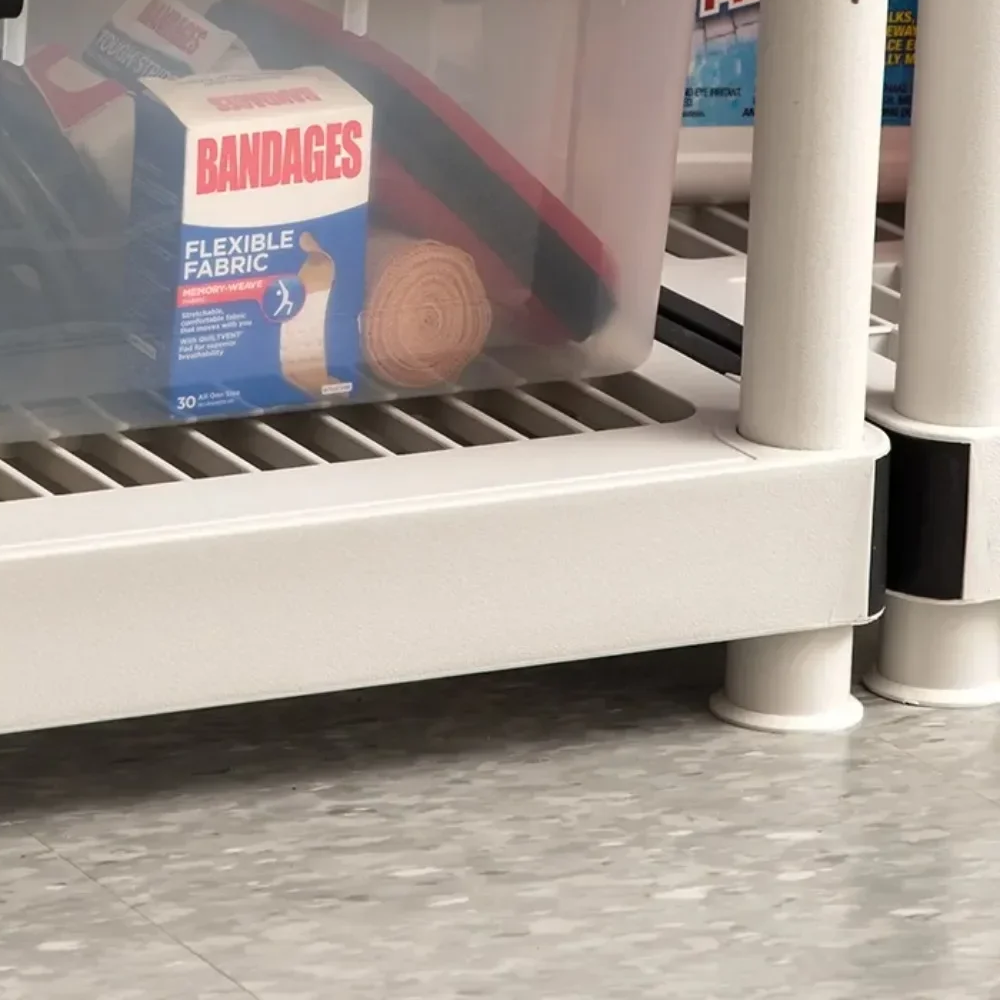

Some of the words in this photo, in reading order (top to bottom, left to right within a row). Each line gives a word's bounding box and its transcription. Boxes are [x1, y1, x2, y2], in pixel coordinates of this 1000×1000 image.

[196, 120, 363, 195] BANDAGES
[185, 229, 295, 260] FLEXIBLE
[183, 253, 269, 280] FABRIC
[182, 279, 264, 298] MEMORY-WEAVE
[180, 315, 225, 327] comfortable
[225, 312, 247, 321] fabric
[180, 326, 195, 334] that
[195, 323, 220, 332] moves
[221, 320, 238, 329] with
[238, 320, 253, 329] you
[180, 336, 197, 345] With
[193, 343, 205, 351] for
[177, 396, 196, 410] 30
